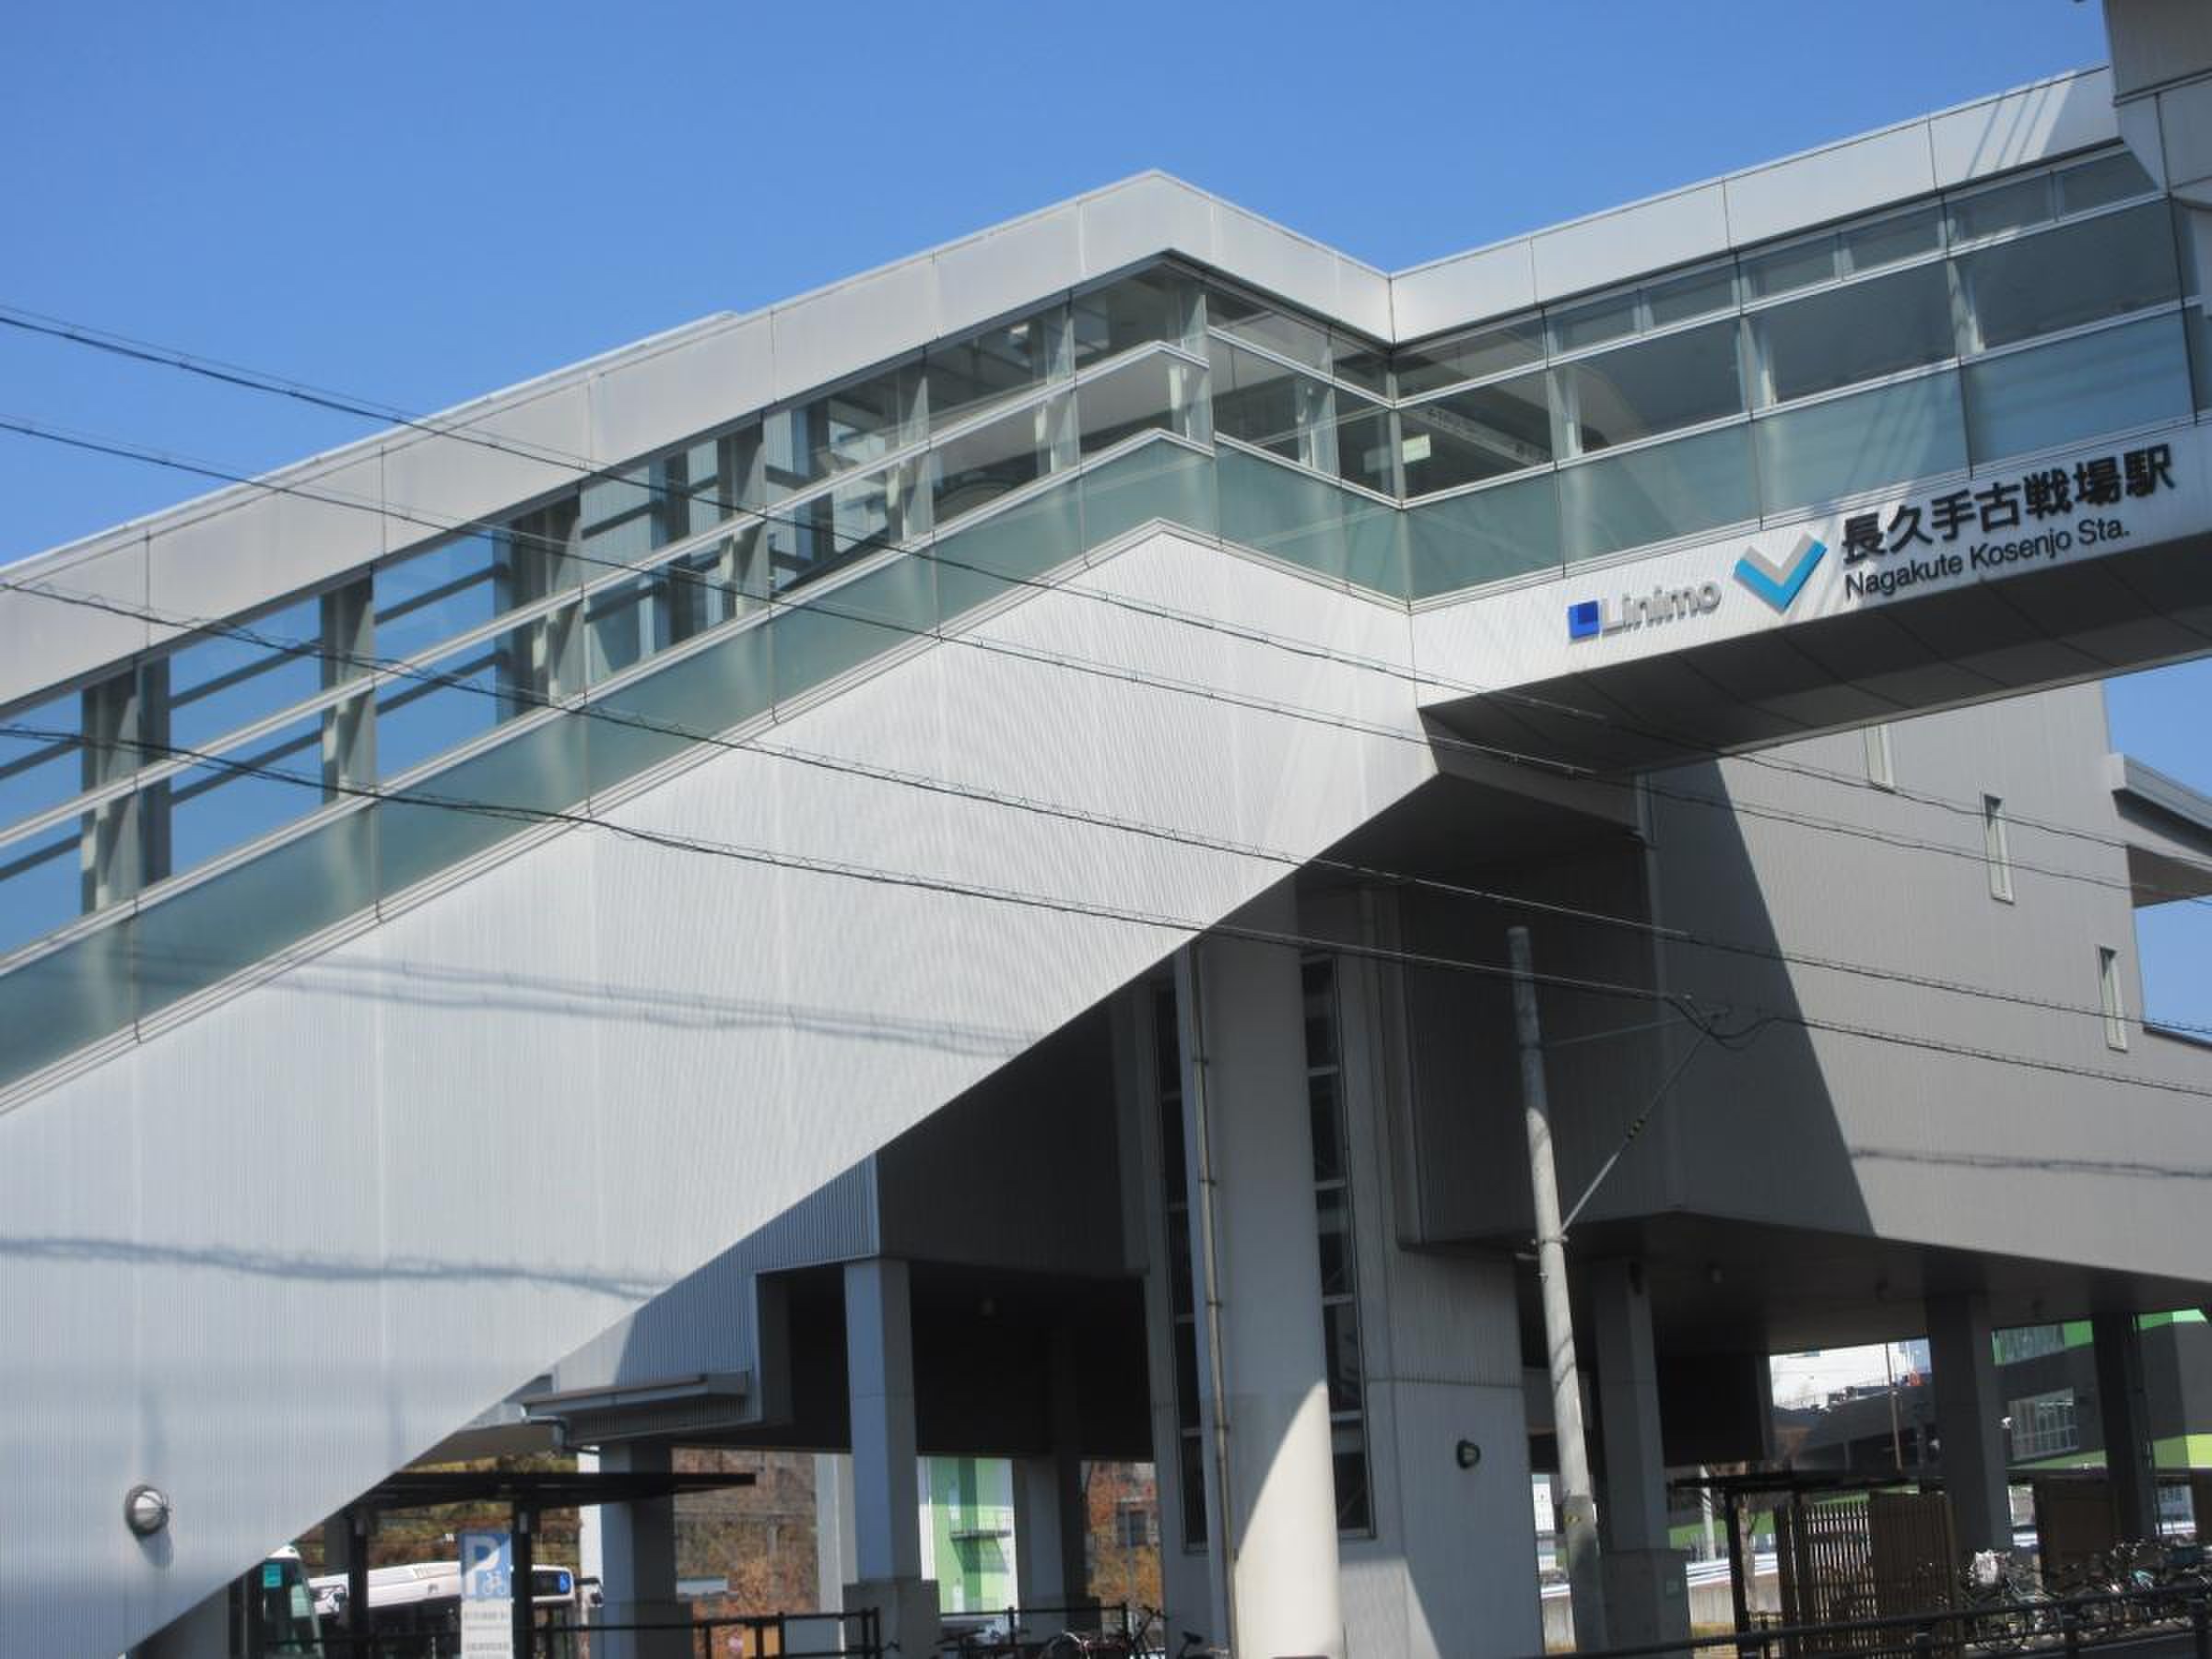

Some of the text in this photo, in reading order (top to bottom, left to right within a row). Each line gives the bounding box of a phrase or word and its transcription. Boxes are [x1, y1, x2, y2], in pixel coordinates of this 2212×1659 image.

[1842, 444, 2176, 565] 長久手古戦場駅
[1845, 518, 2131, 600] Nagakute Kosenjo Sta.
[1599, 582, 1722, 636] Linimo
